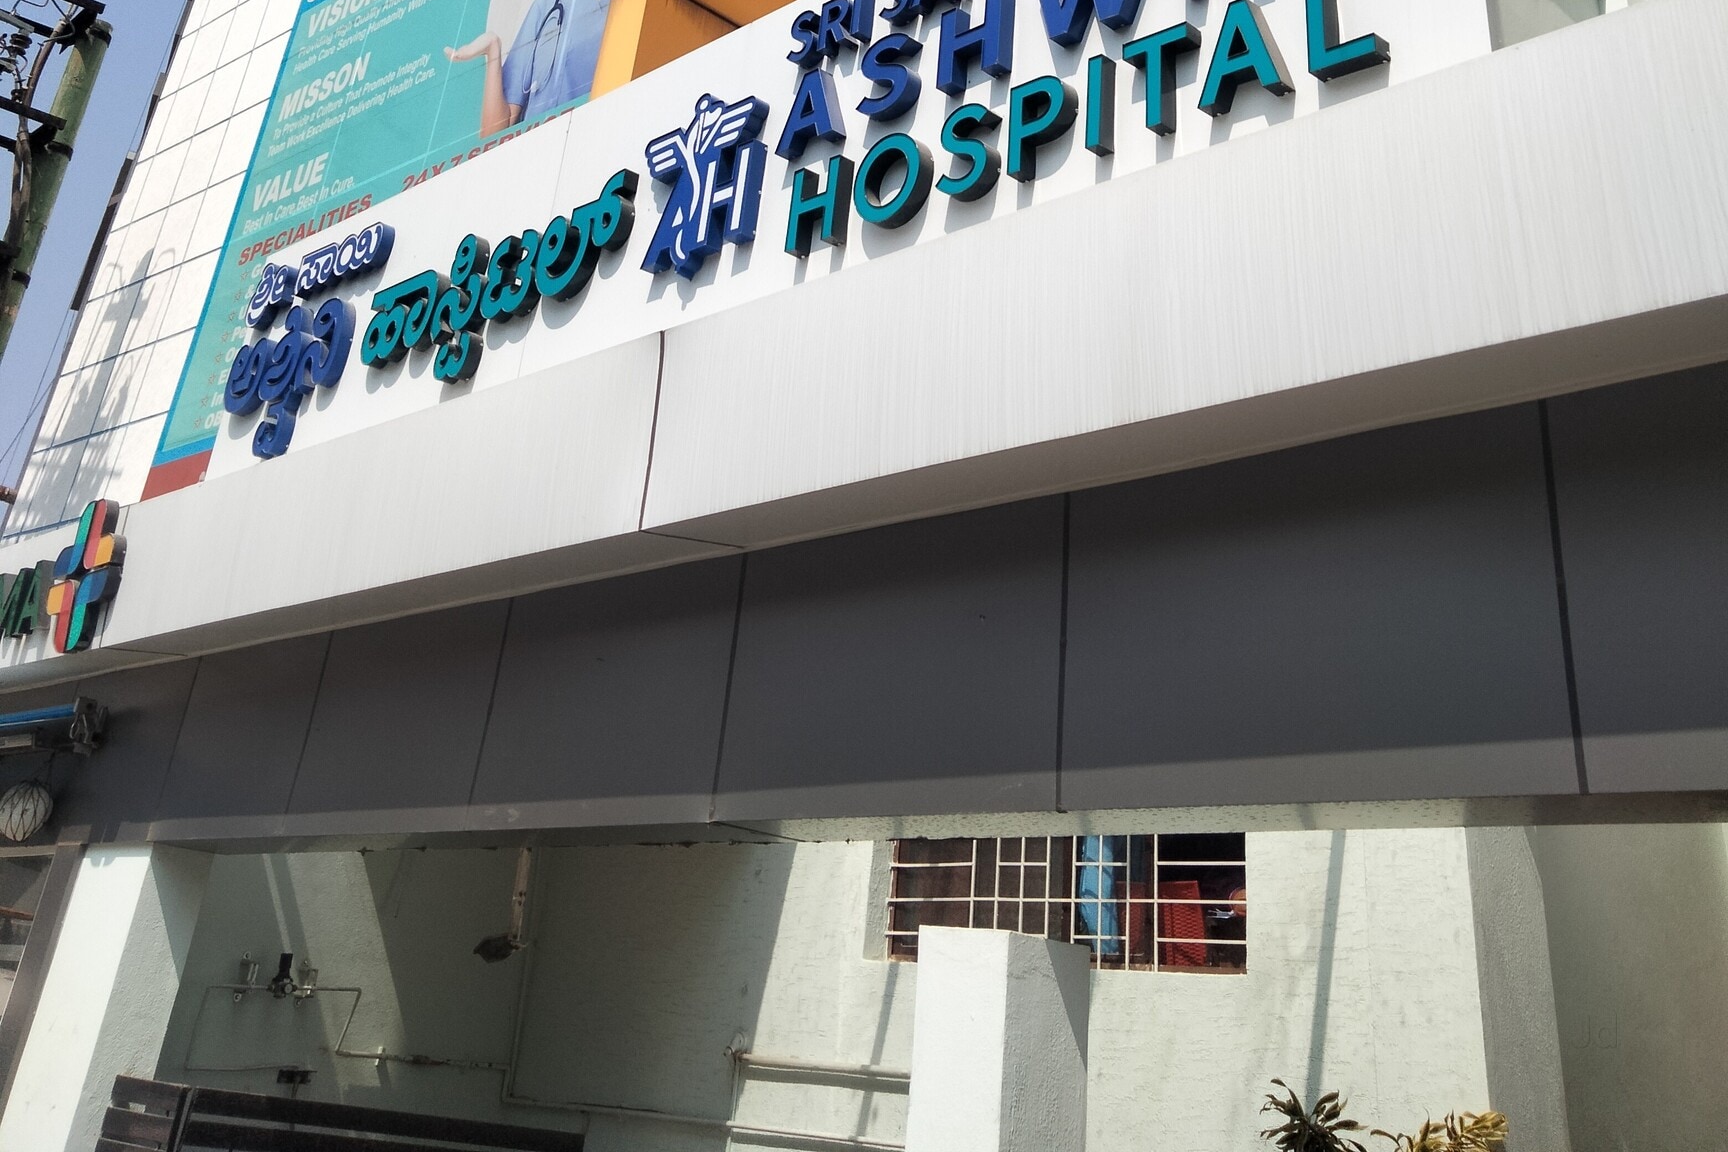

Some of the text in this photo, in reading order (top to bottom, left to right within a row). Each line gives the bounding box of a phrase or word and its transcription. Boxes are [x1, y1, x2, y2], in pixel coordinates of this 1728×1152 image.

[293, 53, 318, 75] Health
[318, 45, 336, 61] Care
[337, 28, 367, 51] Serving
[367, 7, 406, 35] Humanity
[298, 34, 334, 60] Providing
[353, 4, 380, 28] Quality
[278, 51, 371, 122] MISSON
[282, 114, 310, 136] Provide
[344, 86, 362, 105] That
[362, 71, 396, 96] Promote
[396, 53, 431, 79] Integrity
[346, 92, 386, 119] Delivering
[386, 76, 414, 99] Health
[243, 216, 263, 235] Best
[263, 211, 273, 227] In
[319, 184, 329, 201] In
[253, 152, 329, 212] VALUE
[238, 193, 373, 266] SPECIALITIES
[295, 222, 396, 300] ಸಾಯಿ
[361, 168, 640, 385] ಹಾಸ್ಪಿಟಲ್
